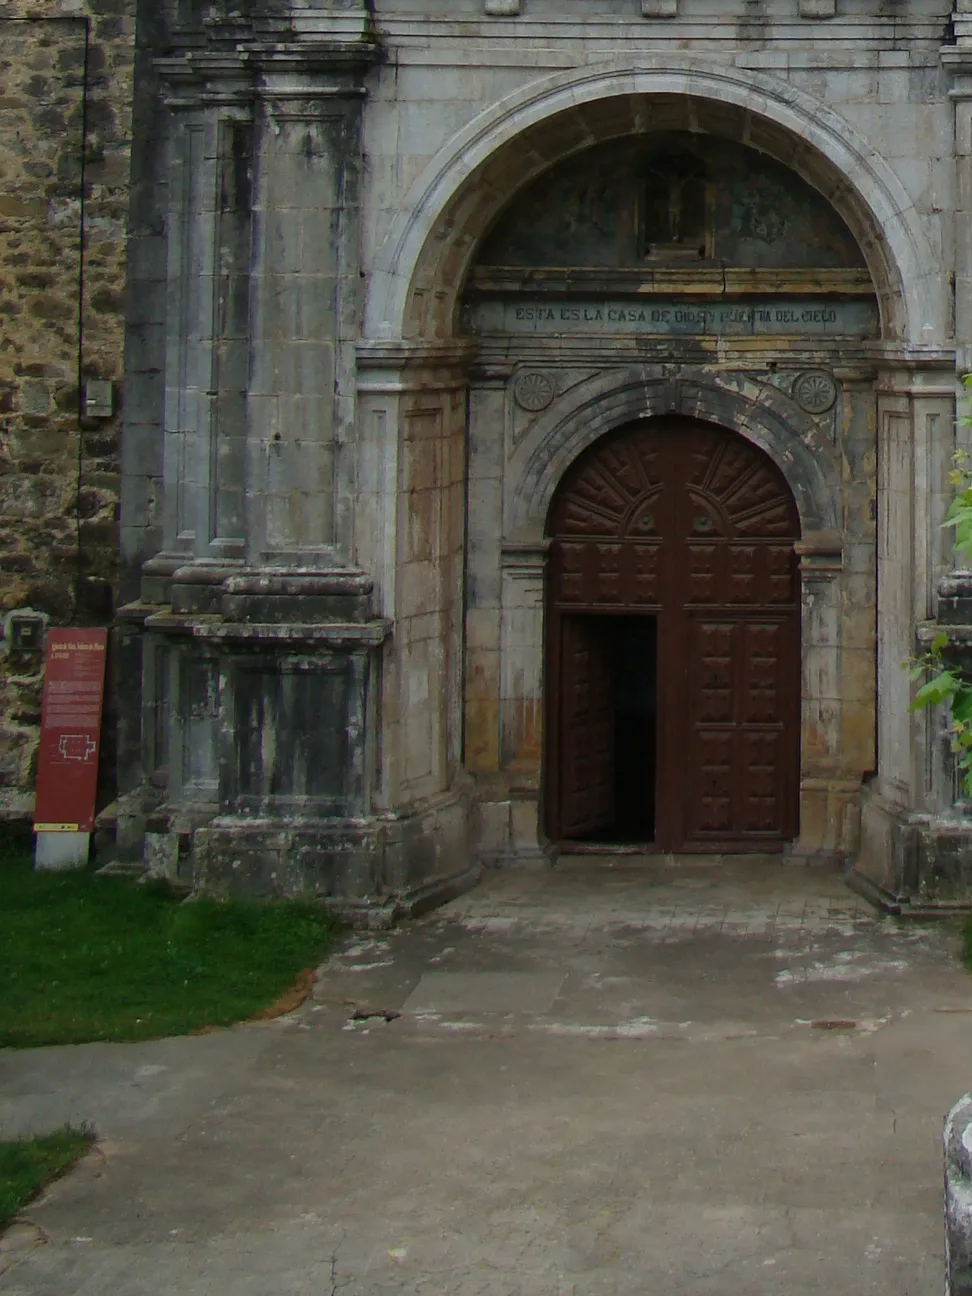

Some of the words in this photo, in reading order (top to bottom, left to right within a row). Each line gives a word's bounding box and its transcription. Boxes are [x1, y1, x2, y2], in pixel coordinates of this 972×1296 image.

[515, 307, 556, 321] ESTA
[559, 307, 581, 321] ES
[583, 308, 603, 321] LA
[607, 309, 647, 322] CASA
[651, 310, 671, 323] DE
[674, 310, 706, 323] DIOS
[775, 310, 800, 323] DEL
[801, 310, 837, 323] CIELO
